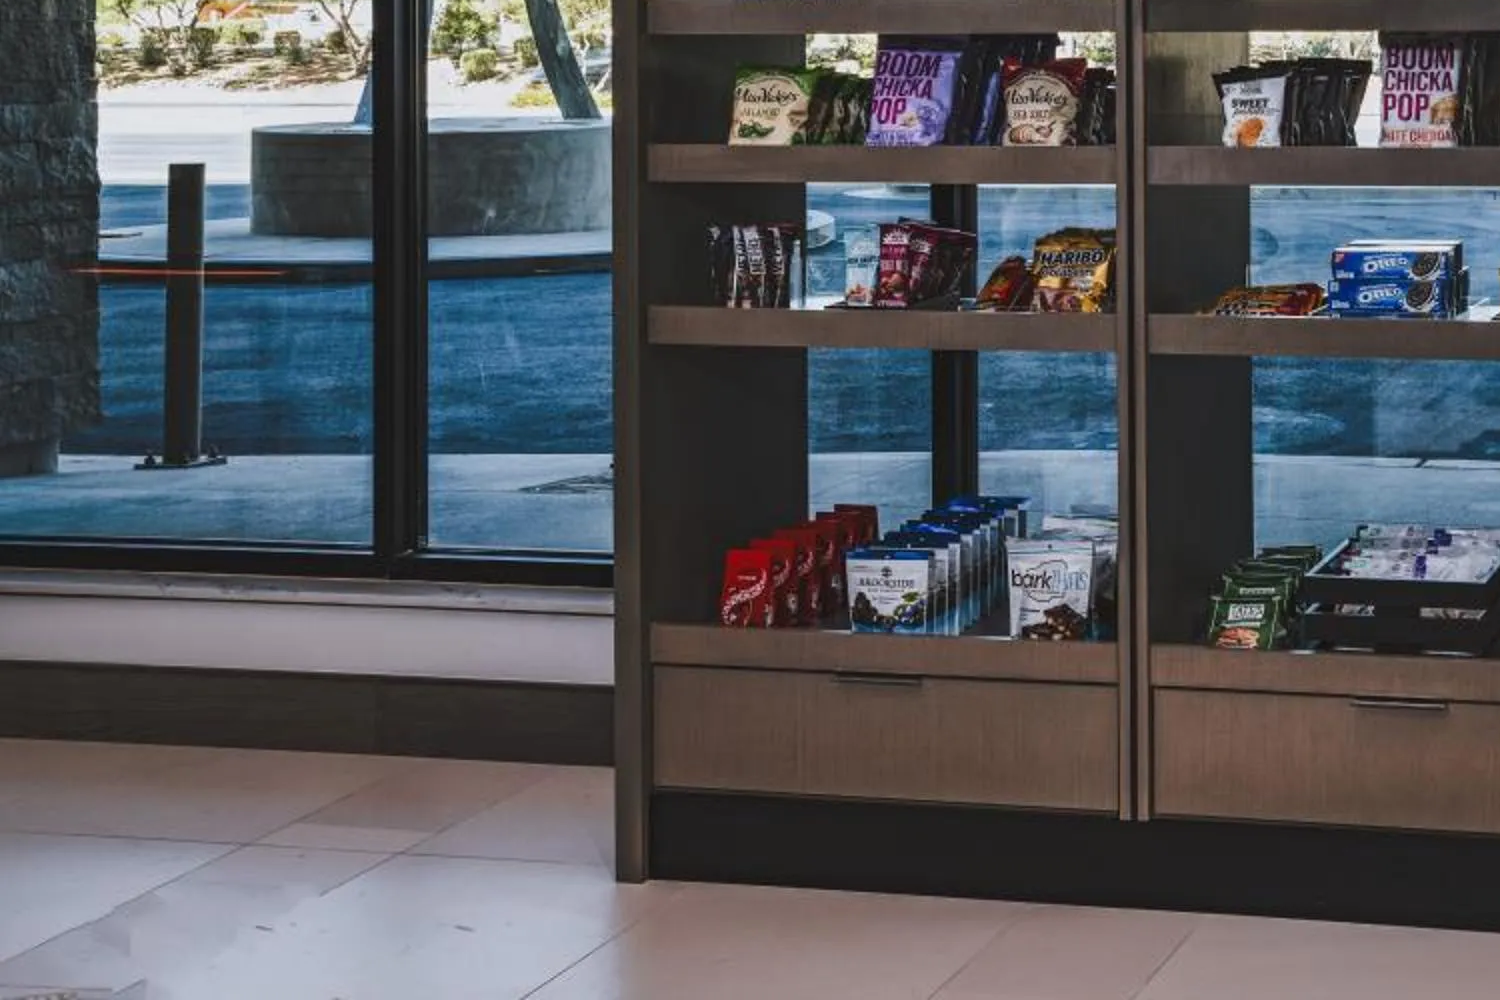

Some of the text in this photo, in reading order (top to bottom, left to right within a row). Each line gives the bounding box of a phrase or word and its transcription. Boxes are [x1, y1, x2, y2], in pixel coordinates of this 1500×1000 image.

[877, 53, 943, 79] BOOM
[1385, 43, 1455, 70] BOOM
[874, 77, 933, 99] CHICKA
[1384, 70, 1454, 91] CHICKA
[871, 98, 907, 125] POP
[1231, 98, 1270, 109] SWEET
[1383, 93, 1430, 122] POP
[1041, 248, 1103, 264] HARIBO
[1363, 257, 1409, 273] OREO
[1358, 287, 1401, 303] OREO
